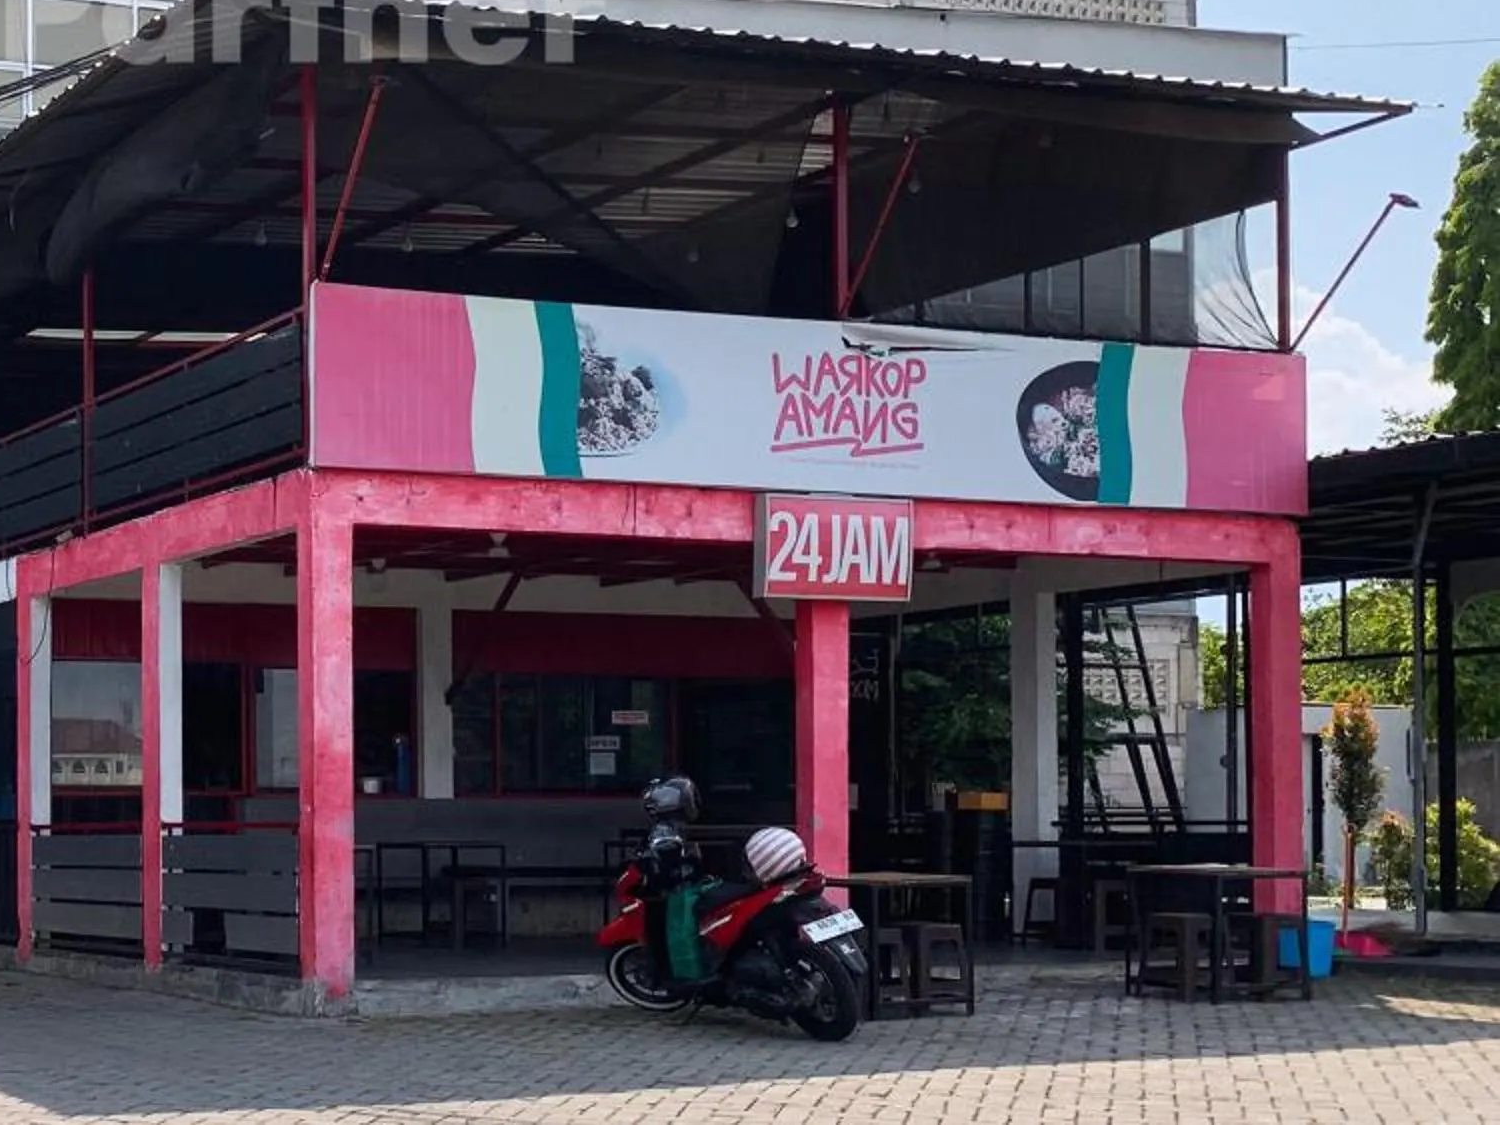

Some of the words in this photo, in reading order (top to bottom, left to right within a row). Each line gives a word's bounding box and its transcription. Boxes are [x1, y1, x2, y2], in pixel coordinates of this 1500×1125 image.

[772, 351, 927, 399] WARKOP
[773, 392, 919, 444] AMANG
[767, 510, 822, 583] 24
[822, 514, 909, 586] JAM
